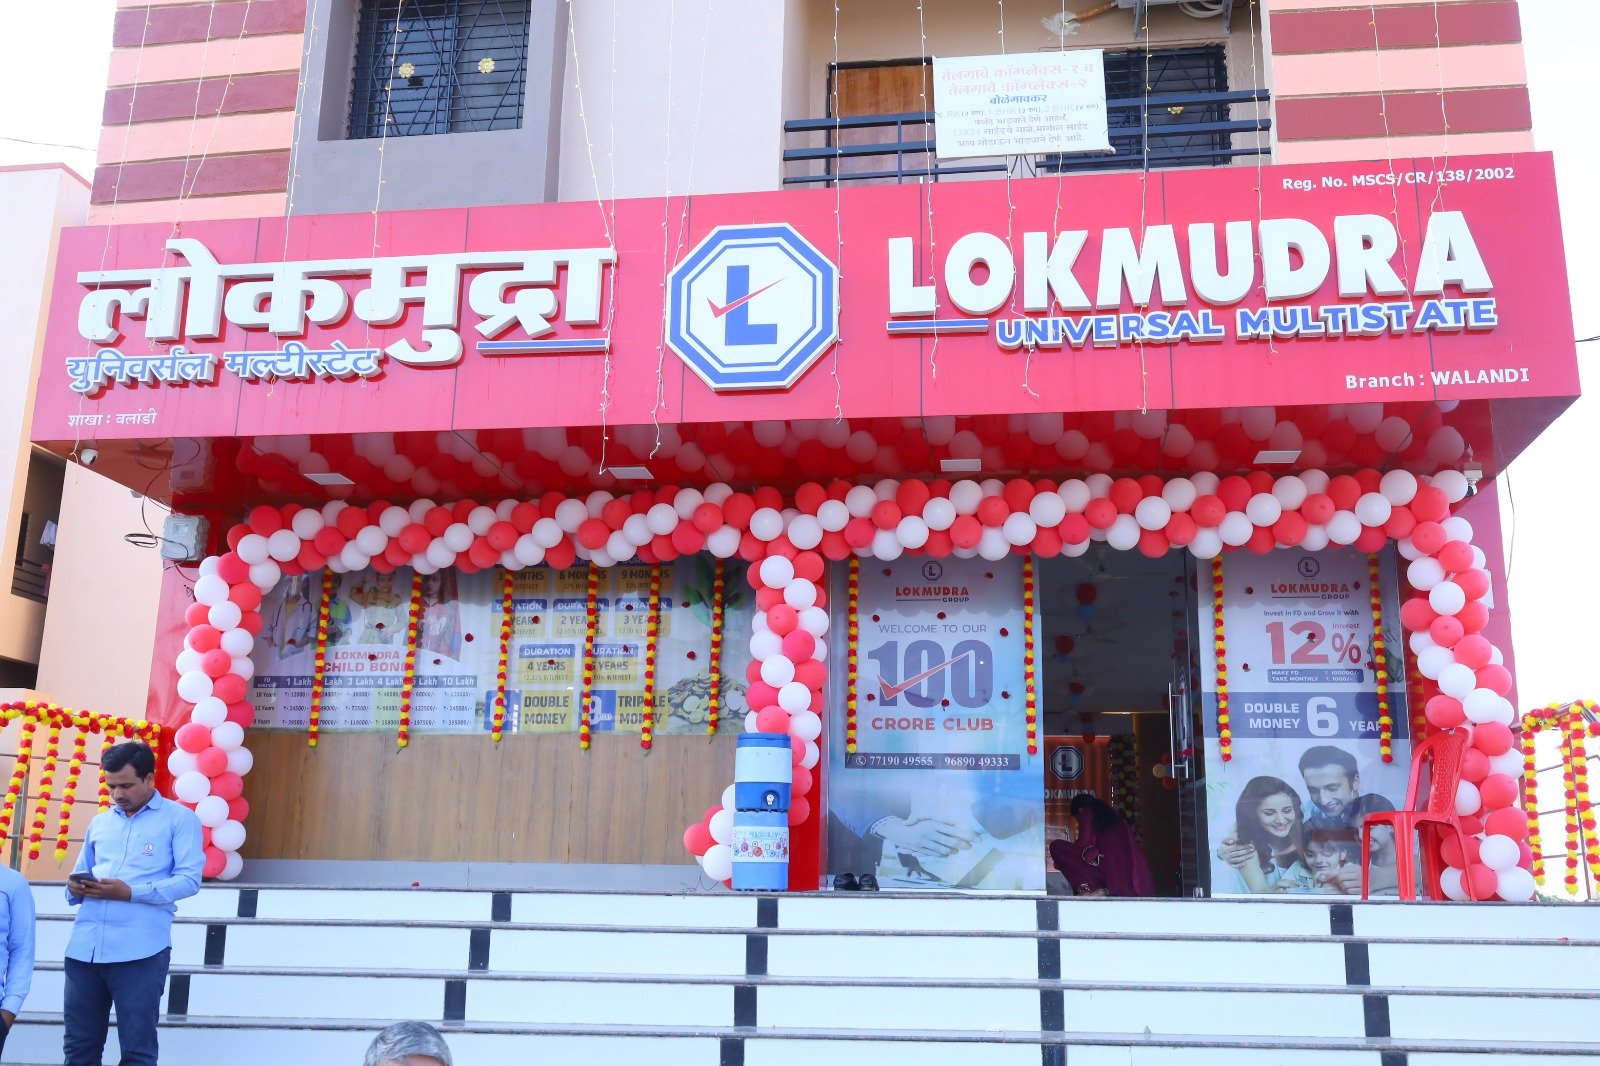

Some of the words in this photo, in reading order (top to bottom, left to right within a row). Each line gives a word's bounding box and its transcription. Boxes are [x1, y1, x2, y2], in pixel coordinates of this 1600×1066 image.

[1282, 178, 1317, 191] Reg.
[1322, 176, 1347, 188] No.
[888, 211, 1494, 318] LOKMUDRA
[77, 237, 617, 366] लोकमुद्रा
[996, 309, 1225, 349] UNIVERSAL
[1431, 367, 1530, 386] WALANDI
[115, 408, 158, 425] वलांडी
[513, 571, 545, 580] ONTHS
[895, 586, 970, 597] LOKMUDRA
[1270, 583, 1349, 594] LOKMUDRA
[496, 602, 543, 610] DRATION
[557, 602, 606, 610] DURATN
[569, 615, 600, 625] YEAS
[878, 624, 938, 634] WELCOME
[942, 624, 958, 634] TO
[962, 624, 987, 634] OUR
[334, 651, 400, 660] LOKMDRA
[524, 647, 571, 656] DURATION
[323, 662, 365, 672] CHILD
[527, 661, 533, 671] 4
[599, 661, 629, 671] YEARS
[867, 639, 994, 709] 100
[293, 677, 312, 686] Lakh
[324, 677, 343, 686] Lakh
[355, 677, 374, 686] Lakh
[418, 677, 438, 686] Lakh
[442, 677, 453, 686] 10
[455, 677, 474, 686] Lakh
[523, 695, 570, 708] DOUBLE
[1244, 702, 1300, 714] DOUBLE
[524, 713, 567, 725] MONEY
[1306, 696, 1340, 737] 6
[871, 717, 936, 731] CRORE
[942, 717, 994, 731] CLUB
[1249, 718, 1301, 729] MONEY
[869, 756, 900, 766] 77190
[902, 756, 933, 766] 49555
[944, 756, 975, 767] 96890
[978, 757, 1009, 767] 49333
